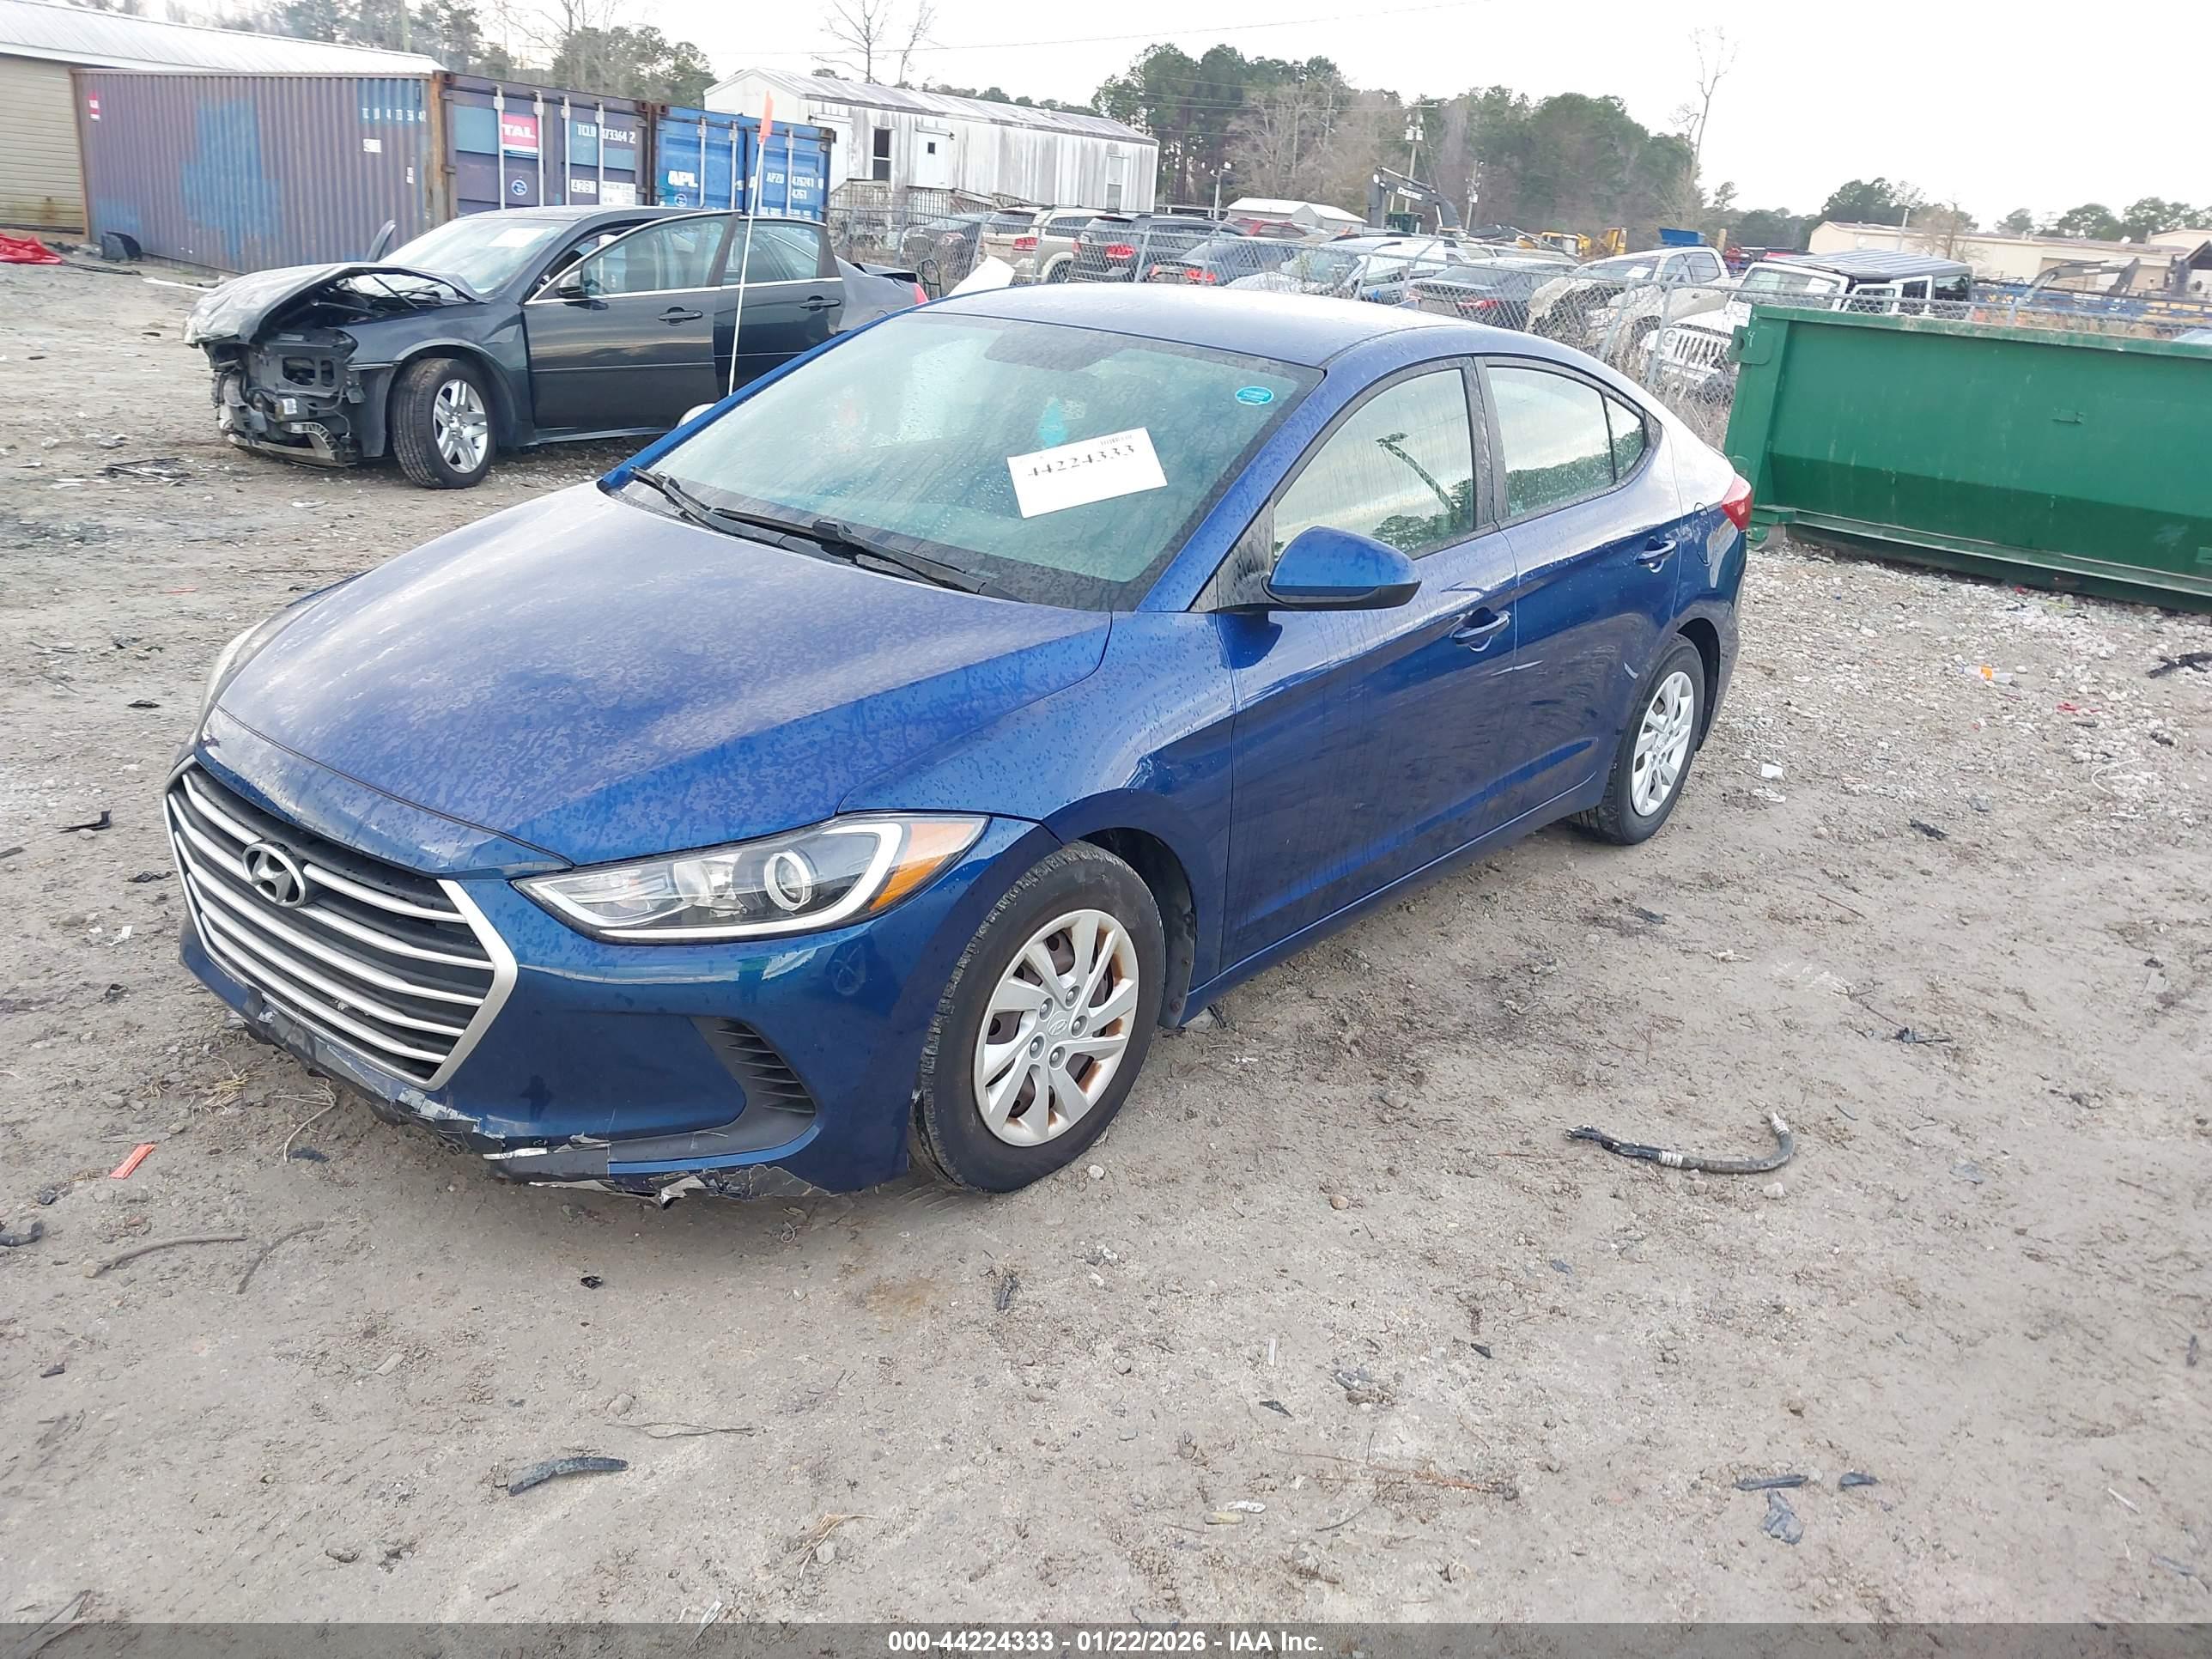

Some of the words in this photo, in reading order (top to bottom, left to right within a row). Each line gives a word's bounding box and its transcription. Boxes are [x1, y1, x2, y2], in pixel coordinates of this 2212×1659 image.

[501, 123, 537, 139] TAL
[629, 131, 636, 144] 2
[668, 170, 699, 188] APL
[1028, 444, 1134, 476] 44224333
